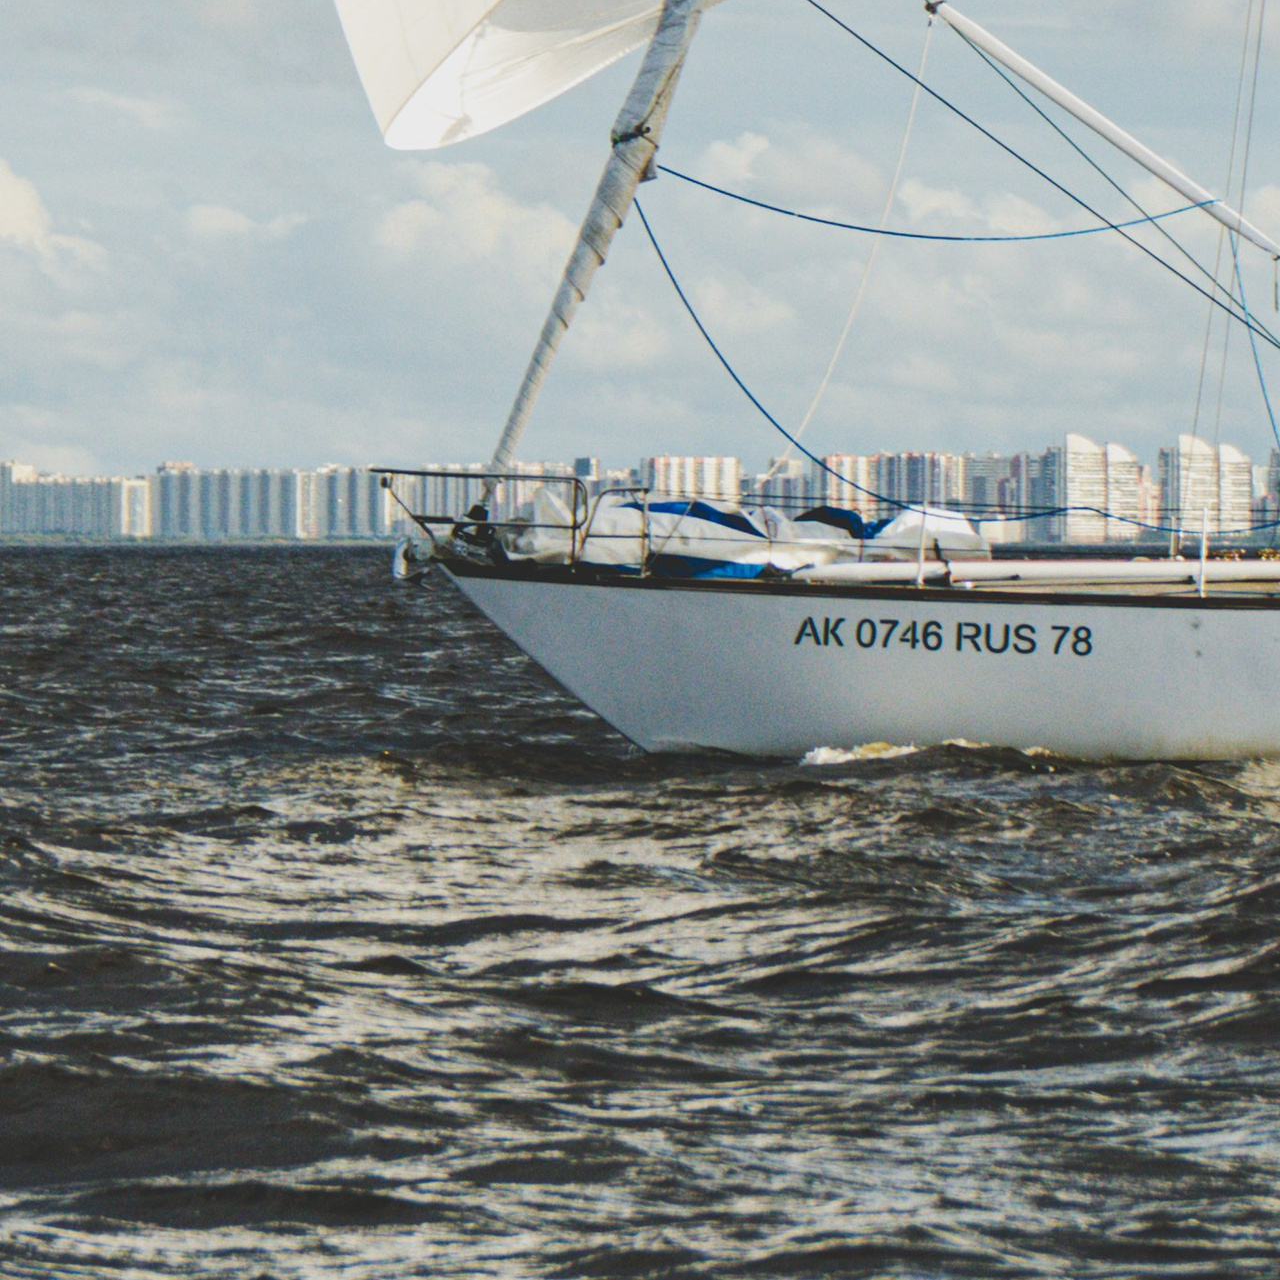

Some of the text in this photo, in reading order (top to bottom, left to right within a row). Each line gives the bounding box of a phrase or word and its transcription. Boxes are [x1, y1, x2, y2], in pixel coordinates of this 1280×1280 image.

[794, 616, 1093, 656] AK 0746 RUS 78
